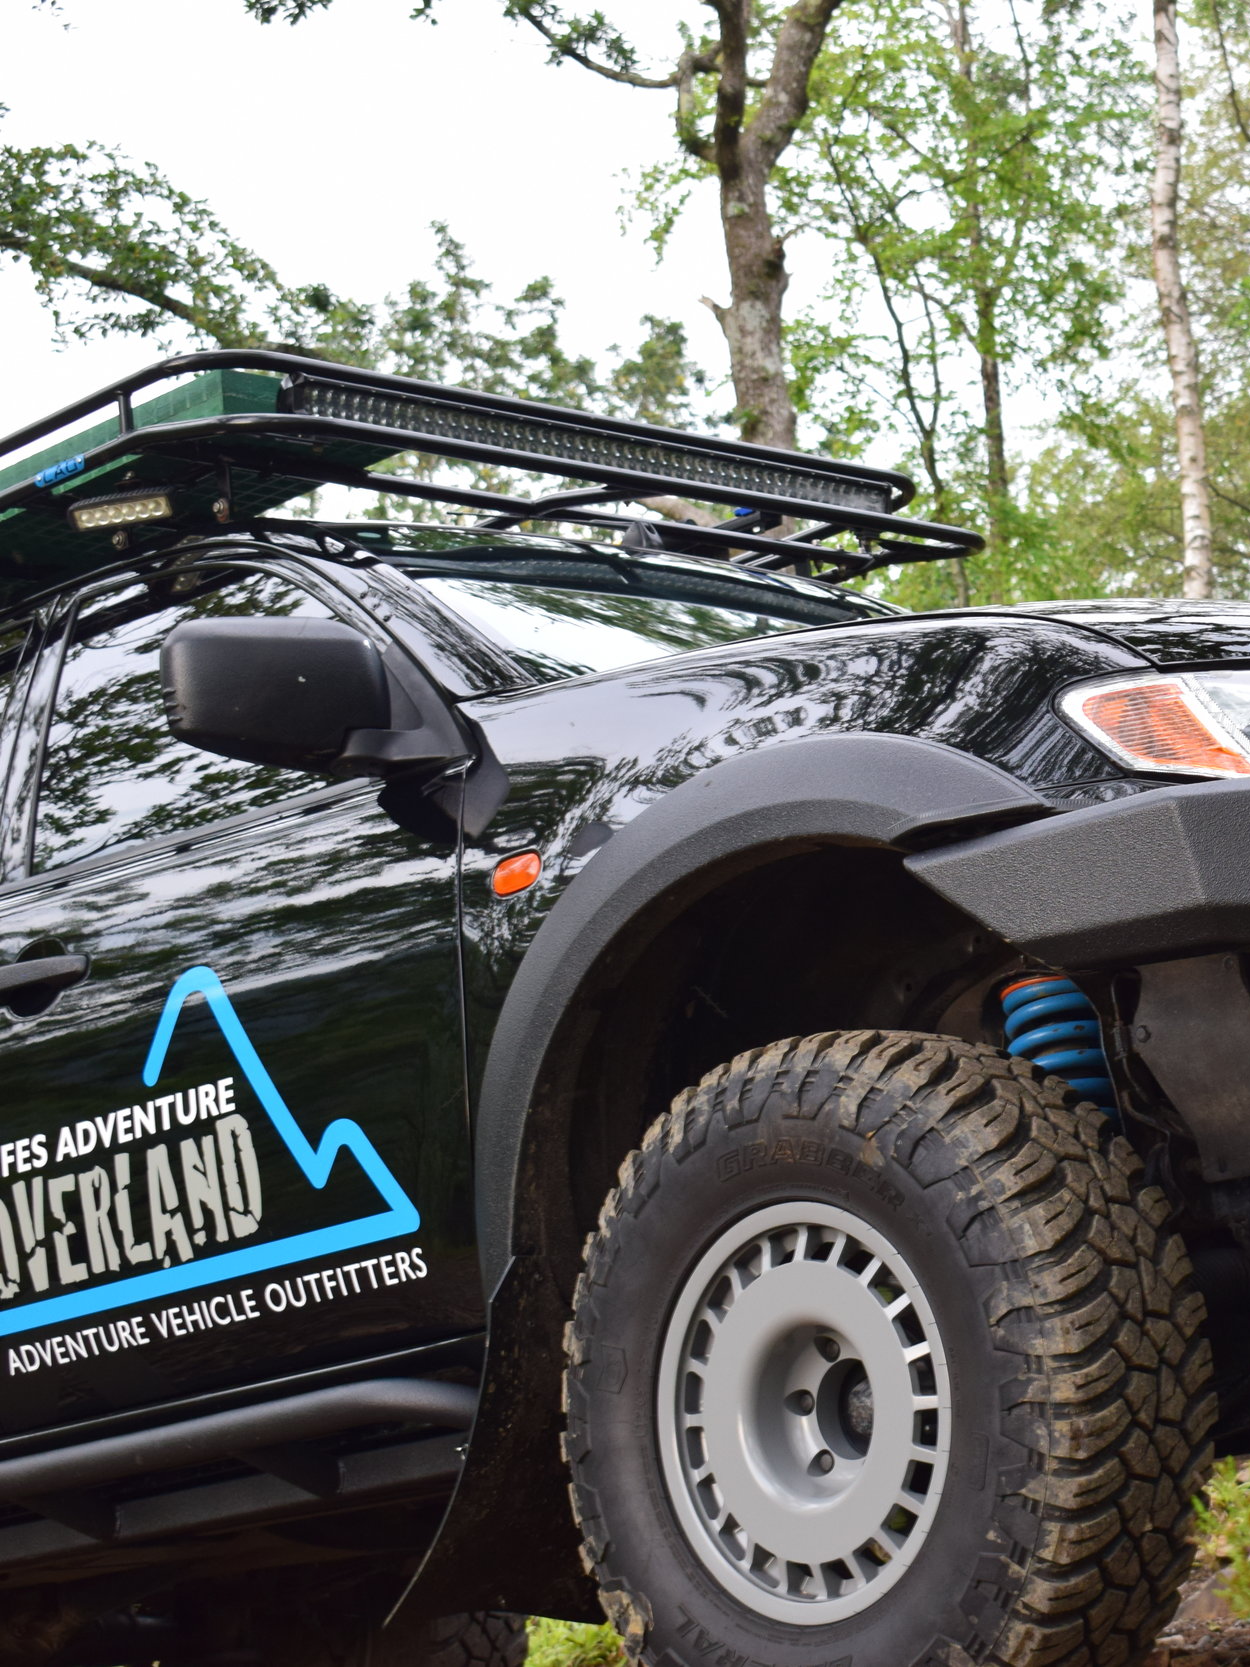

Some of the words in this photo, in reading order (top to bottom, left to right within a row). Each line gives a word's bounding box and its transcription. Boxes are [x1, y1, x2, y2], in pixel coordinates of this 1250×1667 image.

[0, 1133, 49, 1178] FES
[56, 1077, 236, 1163] ADVENTURE
[716, 1136, 906, 1211] GRABBER
[8, 1316, 151, 1376] ADVENTURE
[150, 1288, 261, 1340] VEHICLE
[265, 1247, 428, 1313] OUTFITTERS
